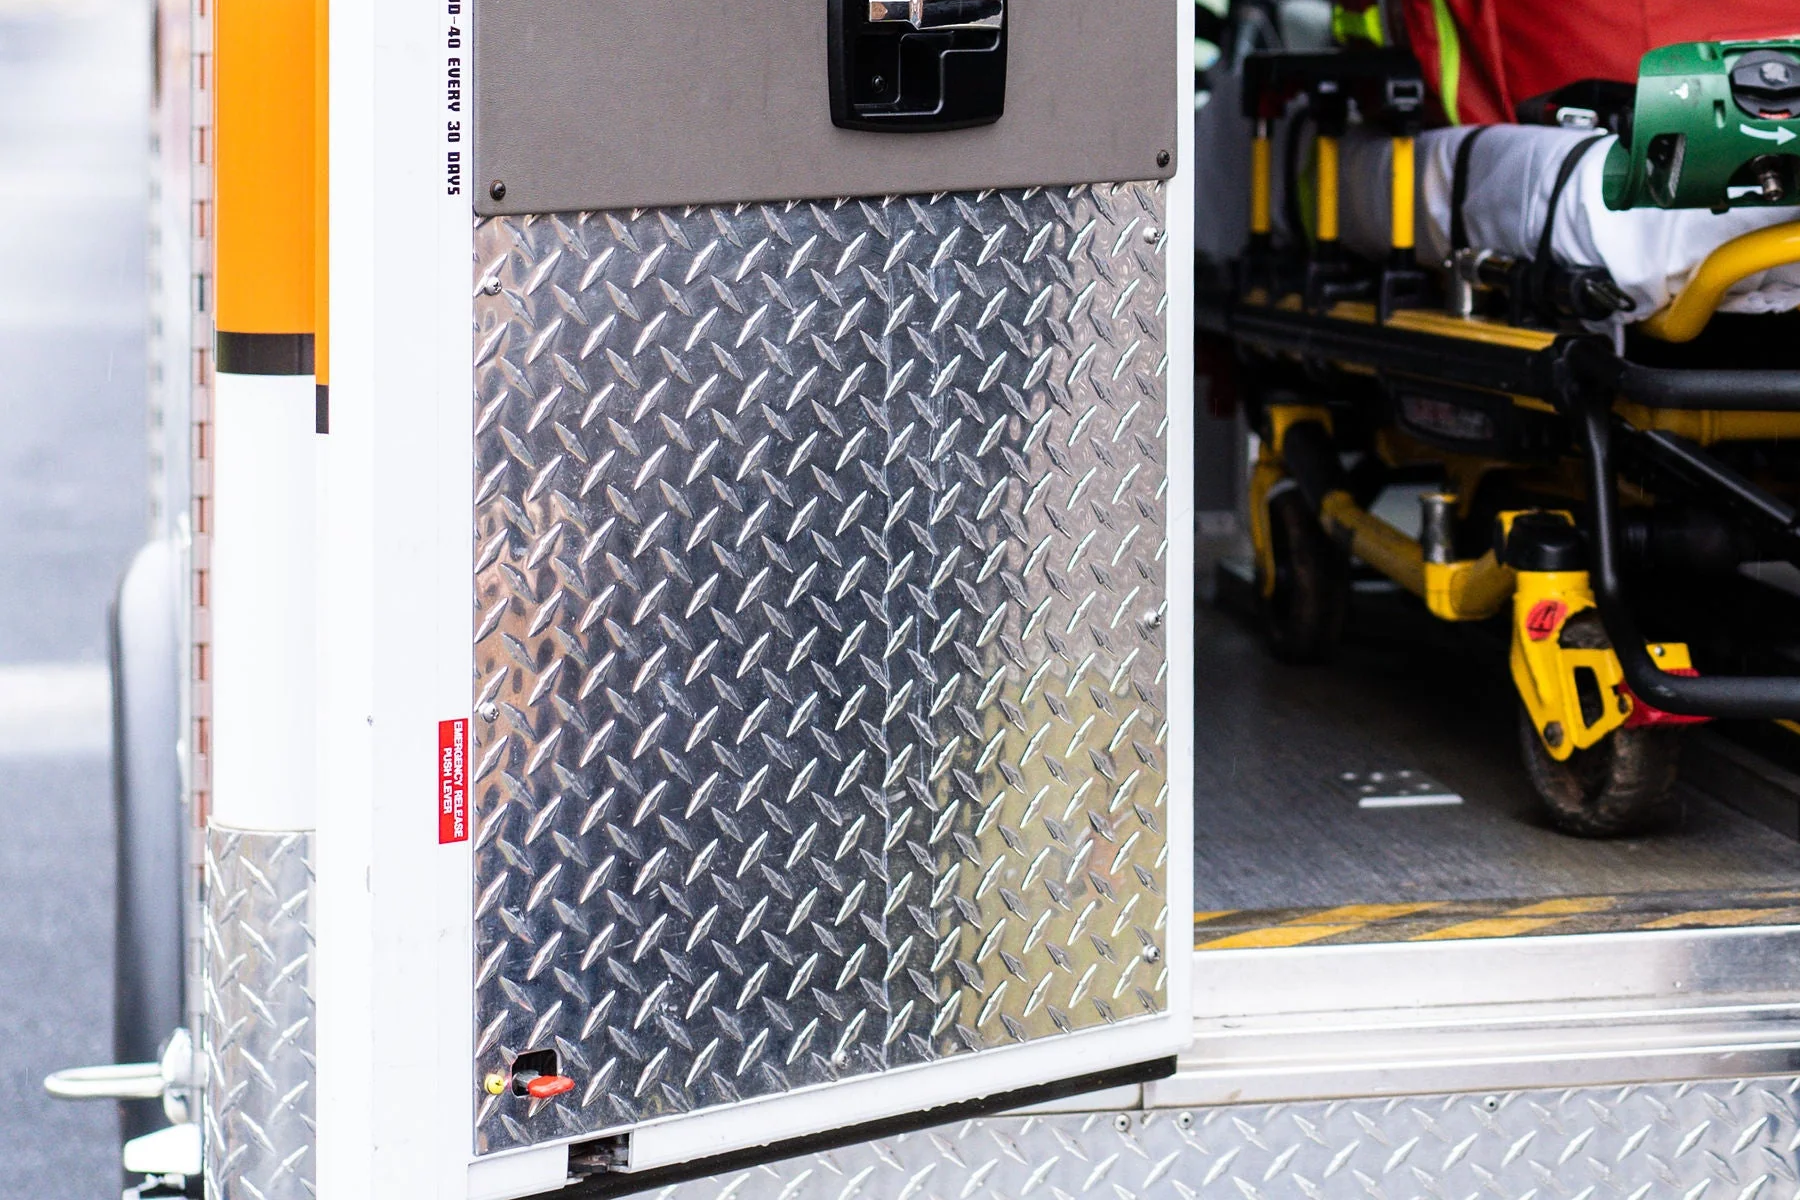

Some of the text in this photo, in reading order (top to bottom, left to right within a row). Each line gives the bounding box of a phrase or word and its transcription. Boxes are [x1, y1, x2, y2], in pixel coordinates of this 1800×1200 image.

[447, 57, 460, 112] EVERY
[447, 120, 461, 142] 30
[447, 152, 460, 195] DAYS
[443, 747, 453, 814] PUSH LEVER
[453, 721, 463, 838] EMERGENCY RELEASE
